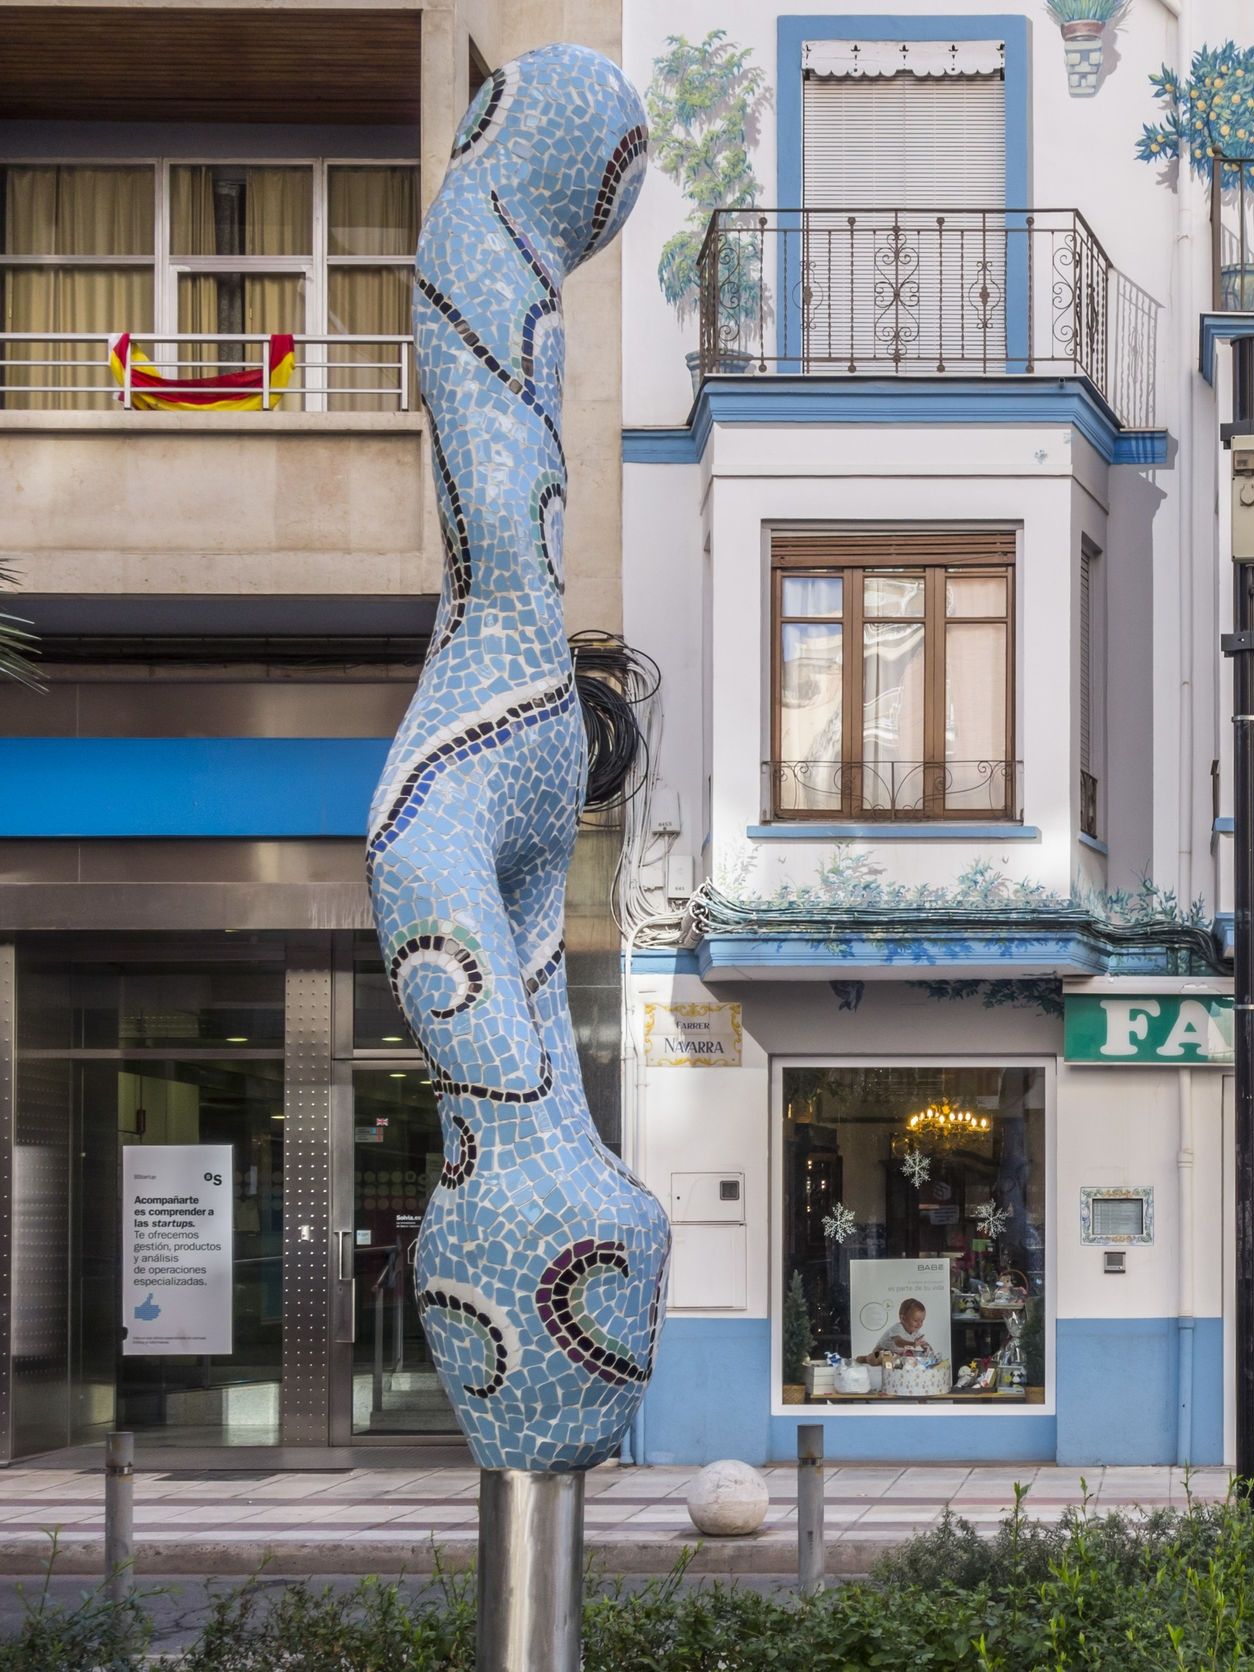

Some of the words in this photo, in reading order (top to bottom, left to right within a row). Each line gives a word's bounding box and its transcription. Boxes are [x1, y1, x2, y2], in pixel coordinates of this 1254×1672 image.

[664, 1037, 724, 1053] NAVARRA
[134, 1195, 199, 1206] Acompañarte
[134, 1208, 146, 1216] es
[148, 1207, 206, 1218] comprender
[207, 1208, 214, 1216] a
[134, 1219, 149, 1228] las
[151, 1219, 195, 1229] startups.
[134, 1230, 145, 1239] Te
[147, 1230, 199, 1239] ofrecemos
[133, 1242, 171, 1253] gestión,
[174, 1242, 221, 1254] productos
[133, 1255, 139, 1264] y
[141, 1254, 179, 1263] análisis
[133, 1265, 146, 1274] de
[148, 1265, 207, 1276] operaciones
[133, 1277, 207, 1287] especializadas.
